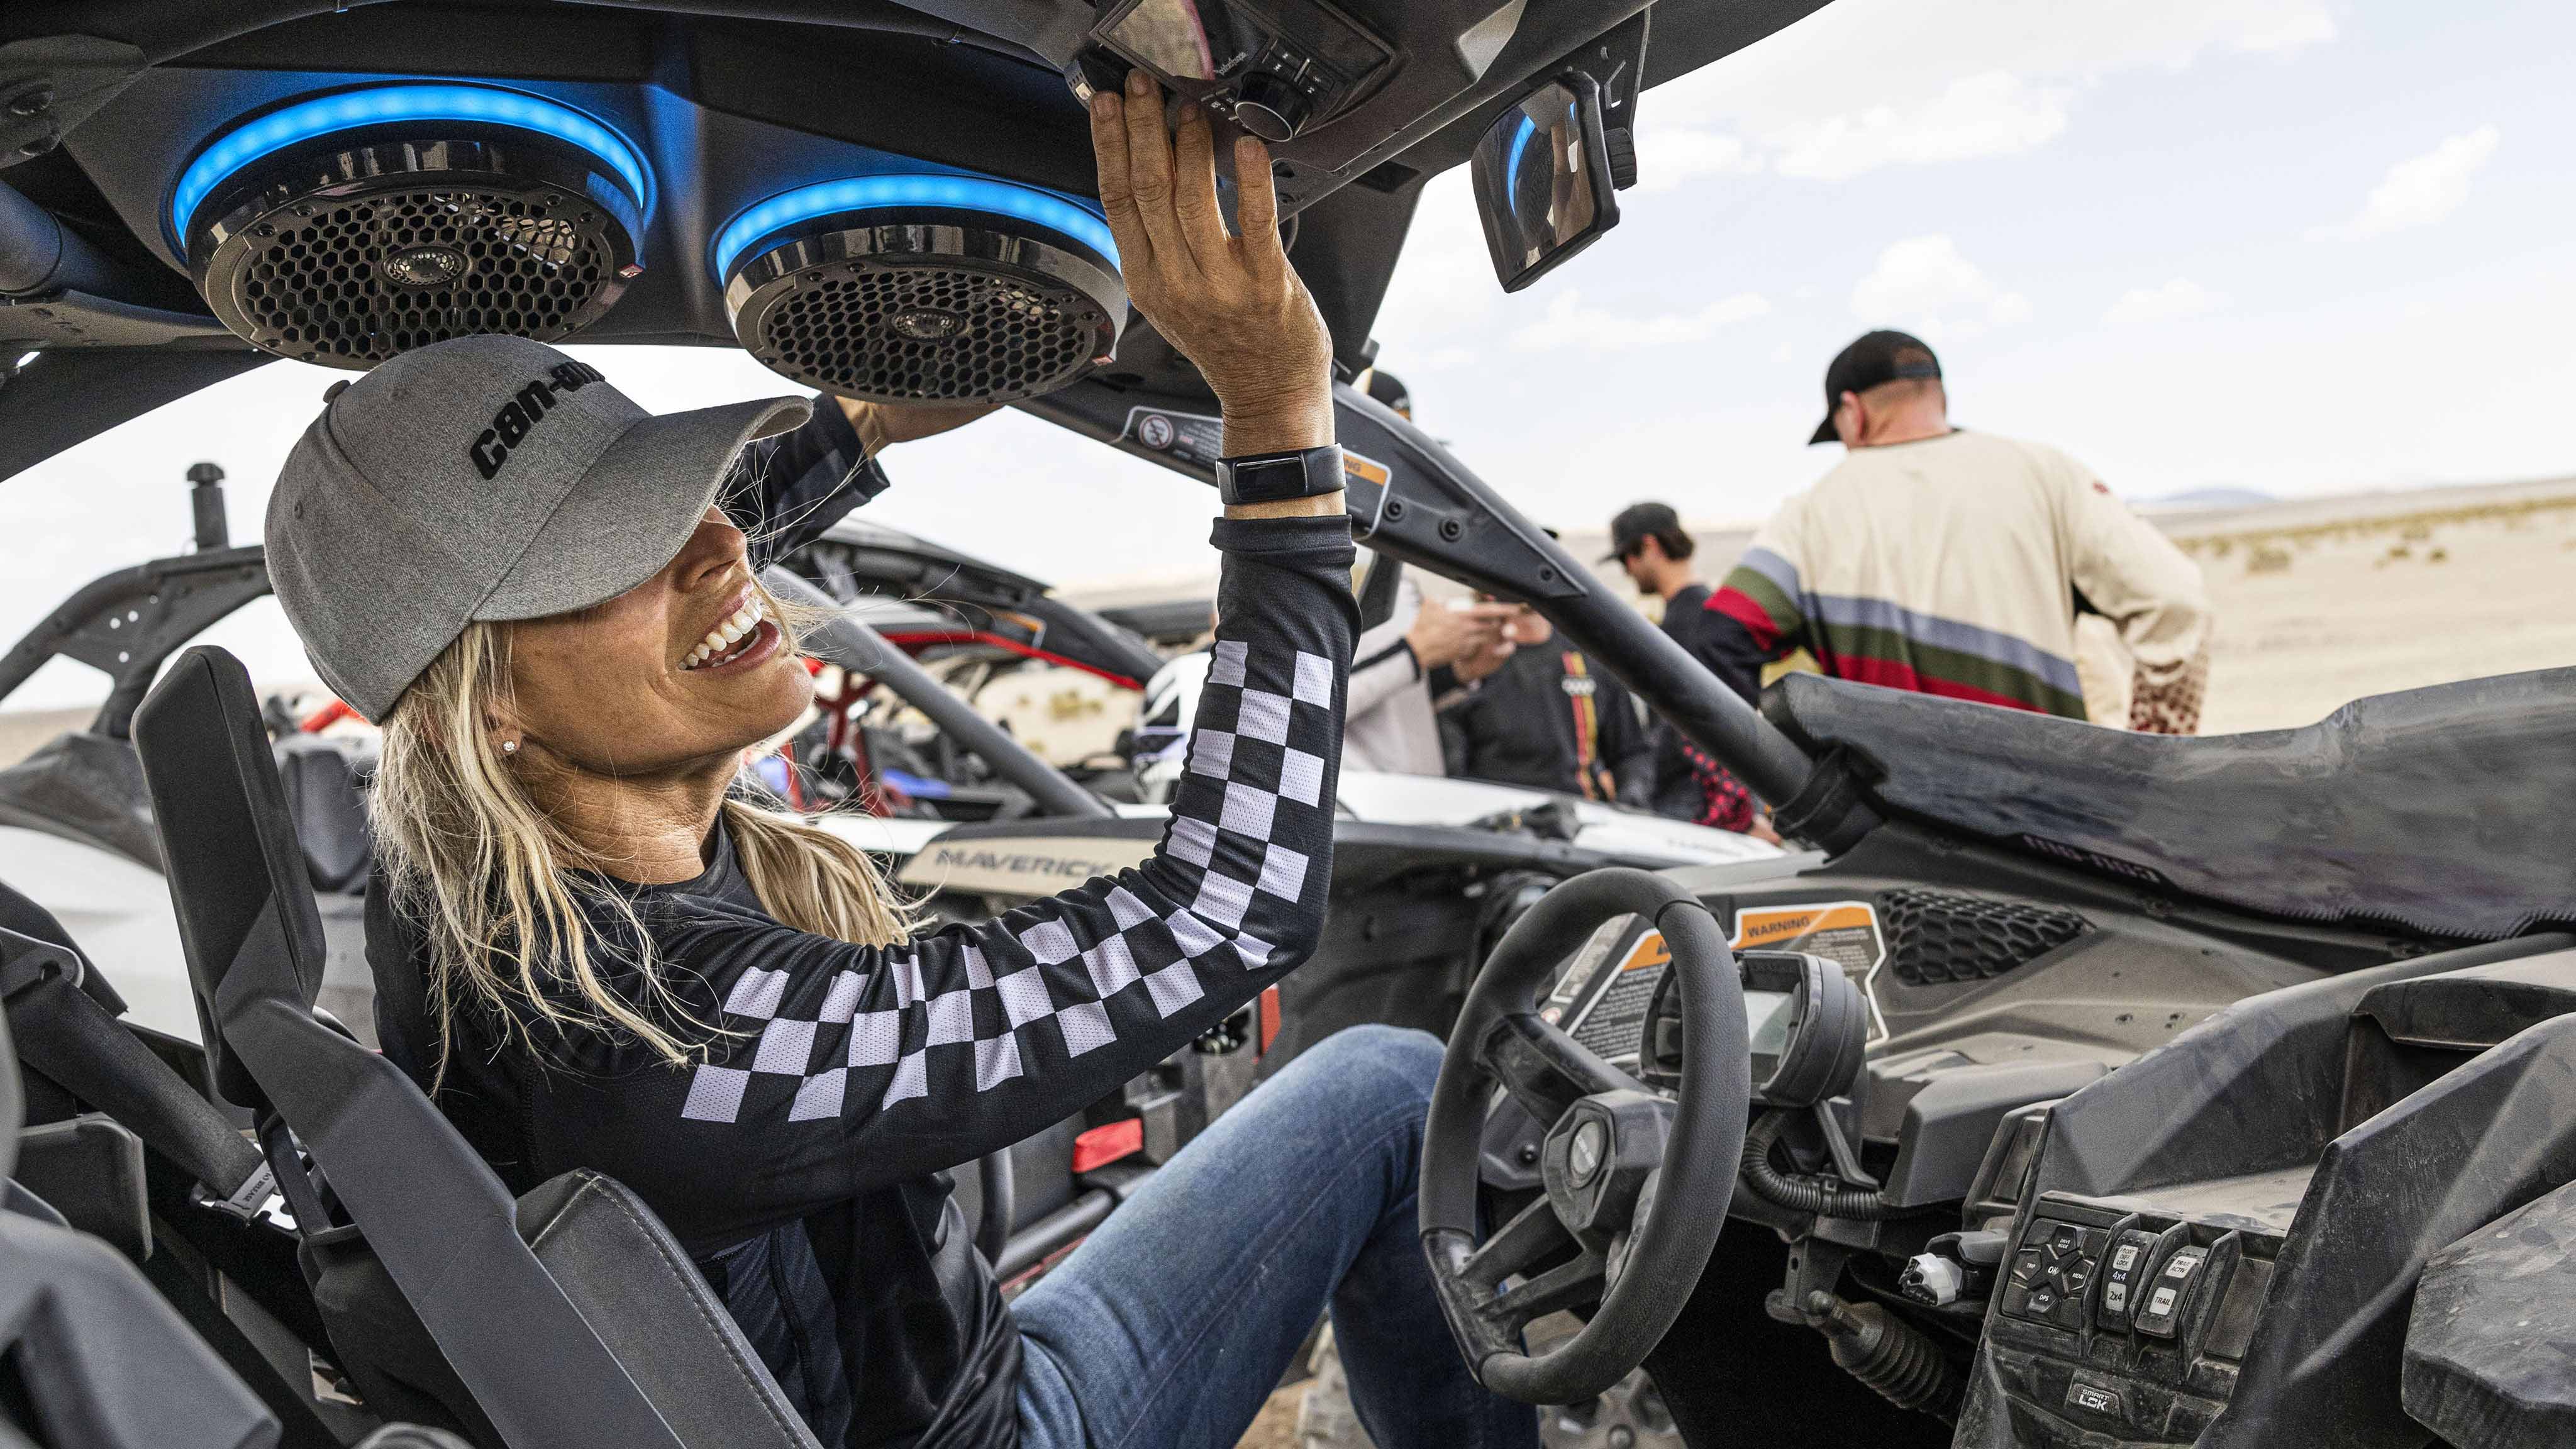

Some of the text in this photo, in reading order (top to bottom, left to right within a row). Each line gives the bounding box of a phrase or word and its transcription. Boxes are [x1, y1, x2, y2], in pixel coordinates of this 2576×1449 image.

[936, 849, 1113, 879] MAVERICK
[1747, 915, 1810, 938] WARNING
[2119, 1247, 2135, 1255] FRONT
[2047, 1267, 2060, 1275] OK
[2112, 1270, 2126, 1281] 4x4
[2109, 1291, 2123, 1302] 2x4
[2154, 1297, 2171, 1306] TRAIL
[2082, 1389, 2109, 1401] SMART
